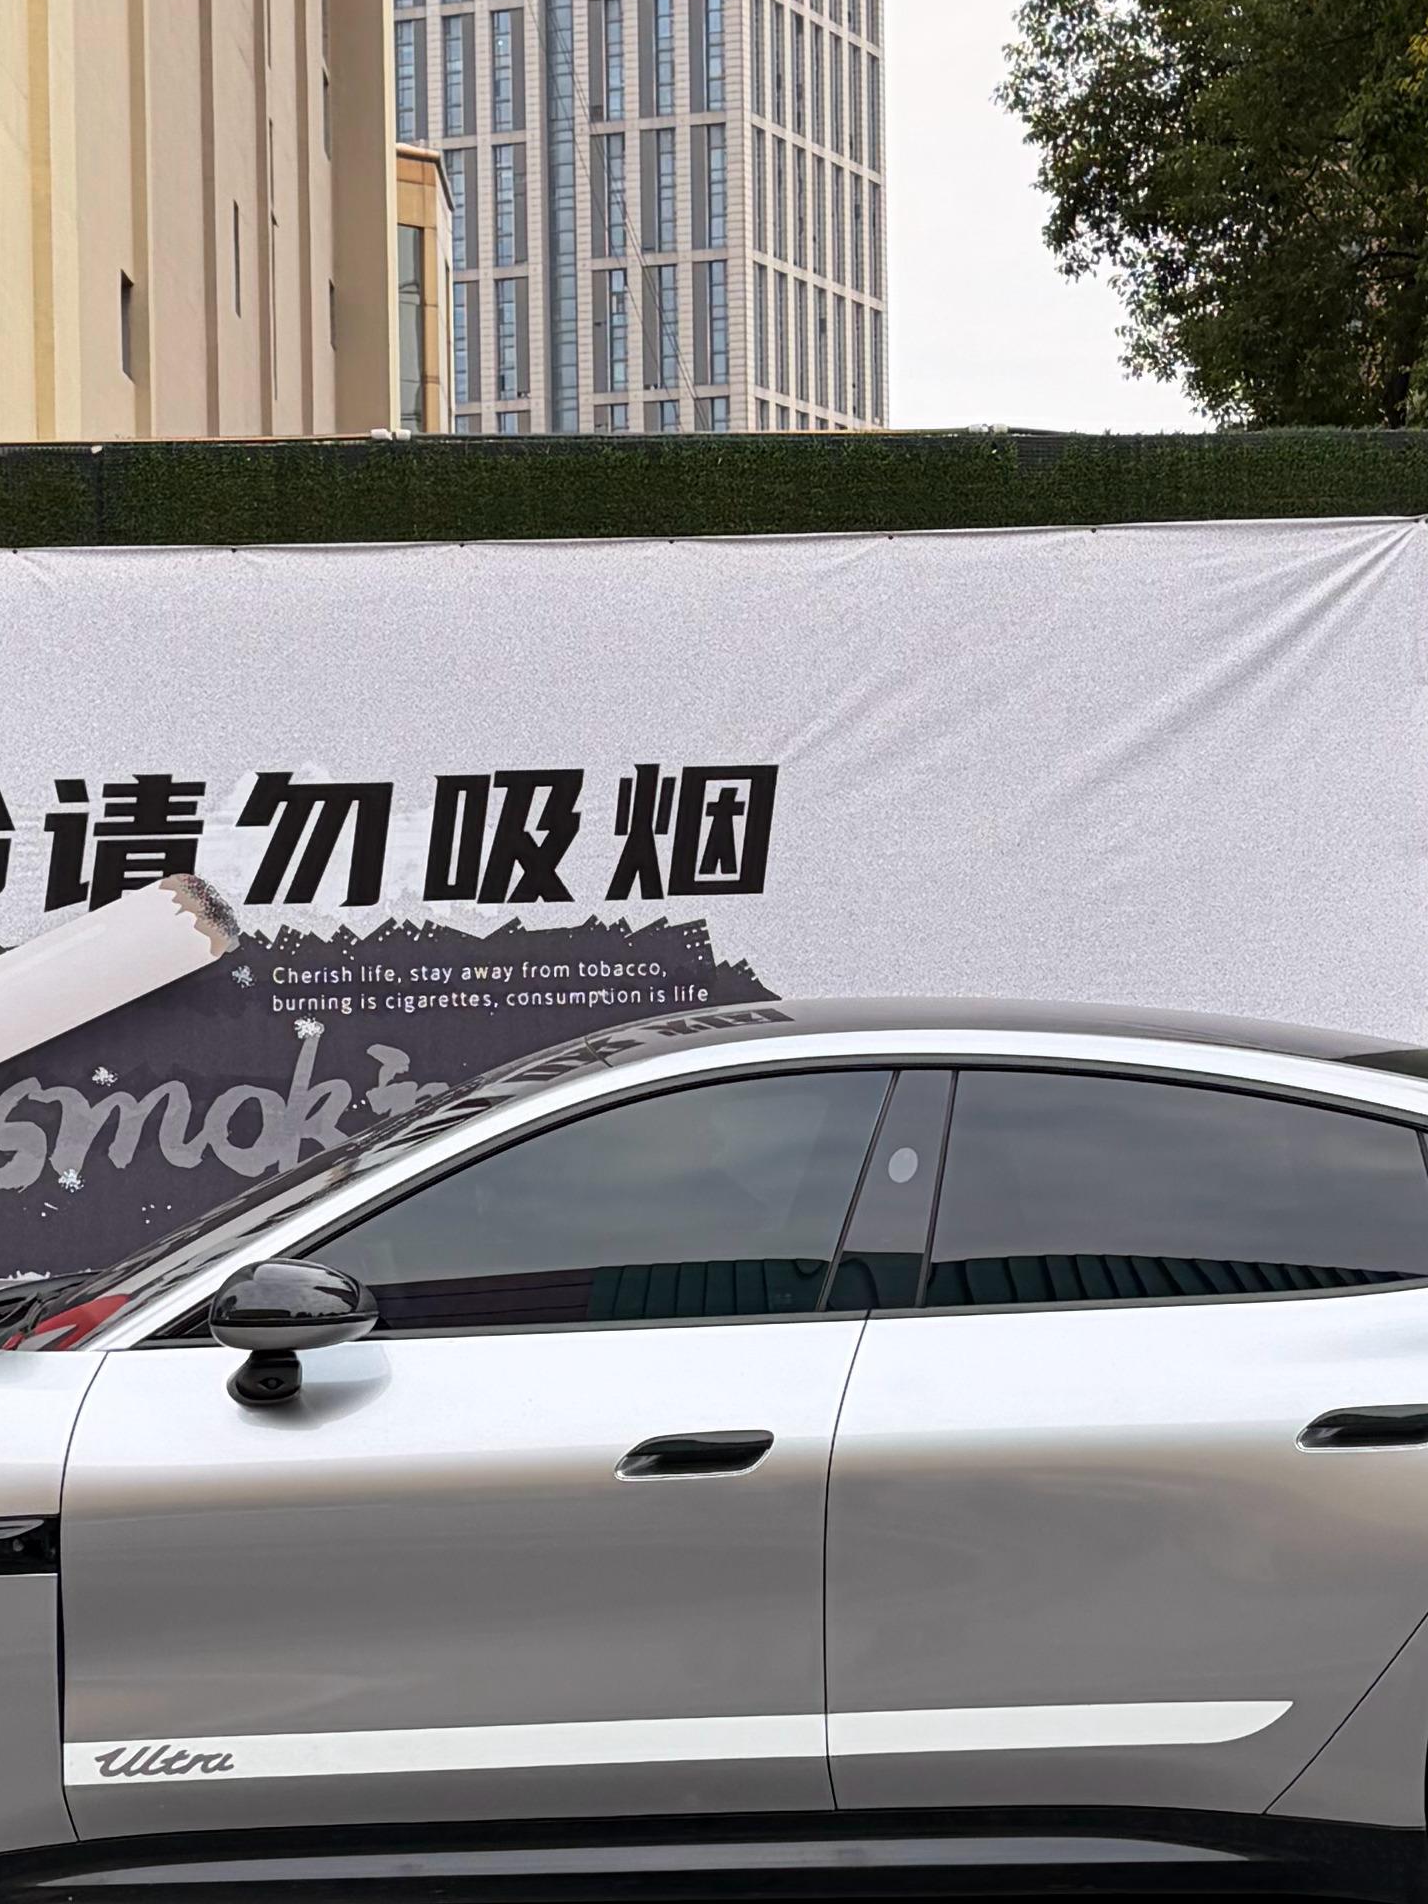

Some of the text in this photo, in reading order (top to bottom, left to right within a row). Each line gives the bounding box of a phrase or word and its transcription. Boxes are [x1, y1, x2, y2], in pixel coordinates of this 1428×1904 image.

[272, 960, 667, 984] Cherish life, stay away from tobacco,
[272, 985, 709, 1014] burning is cigarettes, consumption is life
[94, 1744, 235, 1778] Ultra
